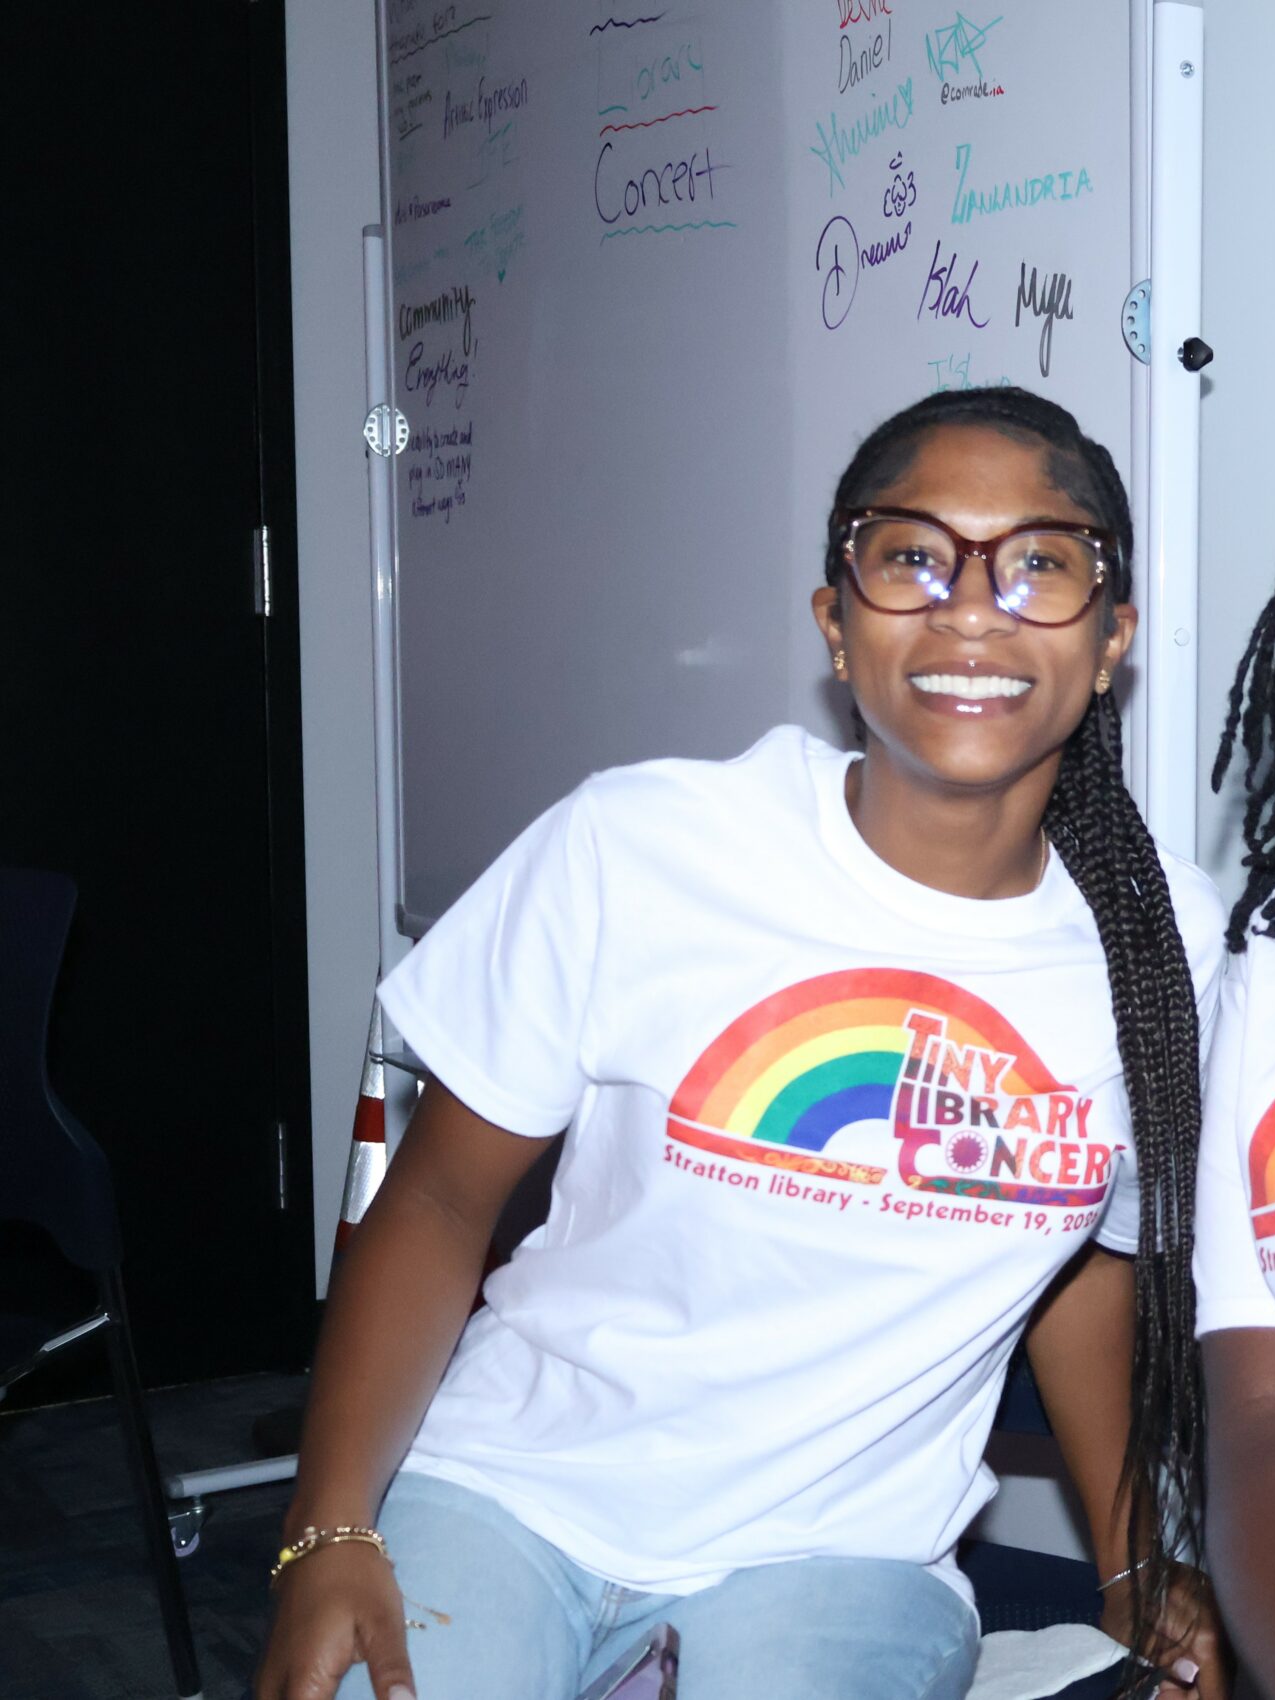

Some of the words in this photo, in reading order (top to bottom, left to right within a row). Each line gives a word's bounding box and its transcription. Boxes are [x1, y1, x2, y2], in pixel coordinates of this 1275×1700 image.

[838, 18, 892, 94] Daniel
[478, 76, 528, 134] Expression
[594, 142, 733, 224] Concert
[904, 1013, 1008, 1094] TINY
[894, 1081, 1093, 1139] LIBRARY
[664, 1144, 759, 1190] Stratton
[769, 1174, 852, 1210] library
[880, 1193, 1014, 1227] September
[1024, 1210, 1052, 1236] 19,
[897, 1128, 1126, 1196] CONCER
